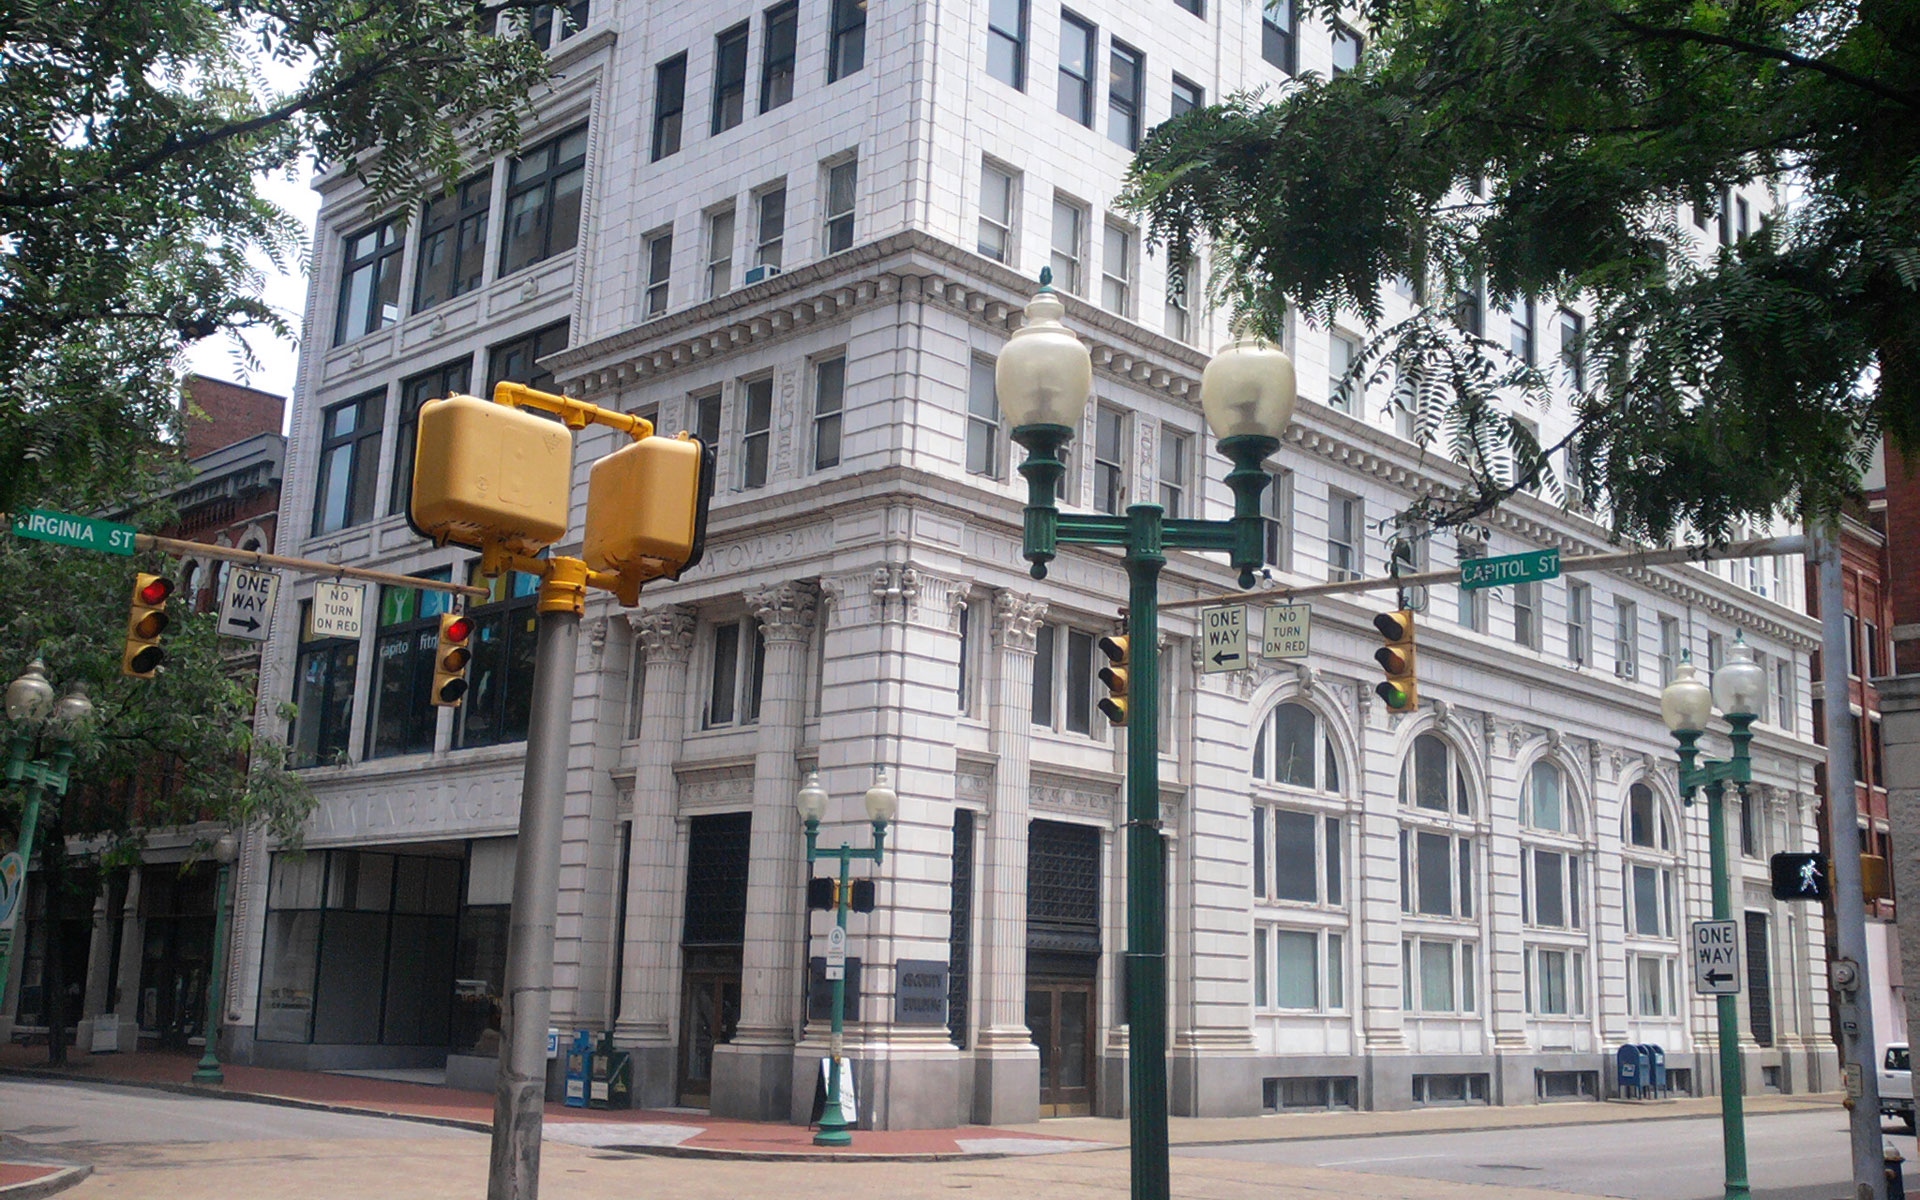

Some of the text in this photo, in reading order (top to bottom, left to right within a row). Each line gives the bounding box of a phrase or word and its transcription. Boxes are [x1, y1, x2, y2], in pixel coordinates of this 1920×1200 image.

[109, 529, 133, 549] ST
[1462, 554, 1558, 583] CAPITOL ST
[236, 574, 271, 594] ONE
[231, 592, 267, 613] WAY
[330, 589, 349, 602] NO
[324, 603, 353, 617] TURN
[1210, 609, 1240, 628] ONE
[1279, 611, 1297, 623] NO
[316, 617, 359, 633] ON RED
[1273, 626, 1301, 638] TURN
[1209, 629, 1240, 646] WAY
[1265, 640, 1306, 653] ON RED
[1699, 926, 1733, 944] ONE
[1699, 947, 1734, 964] WAY
